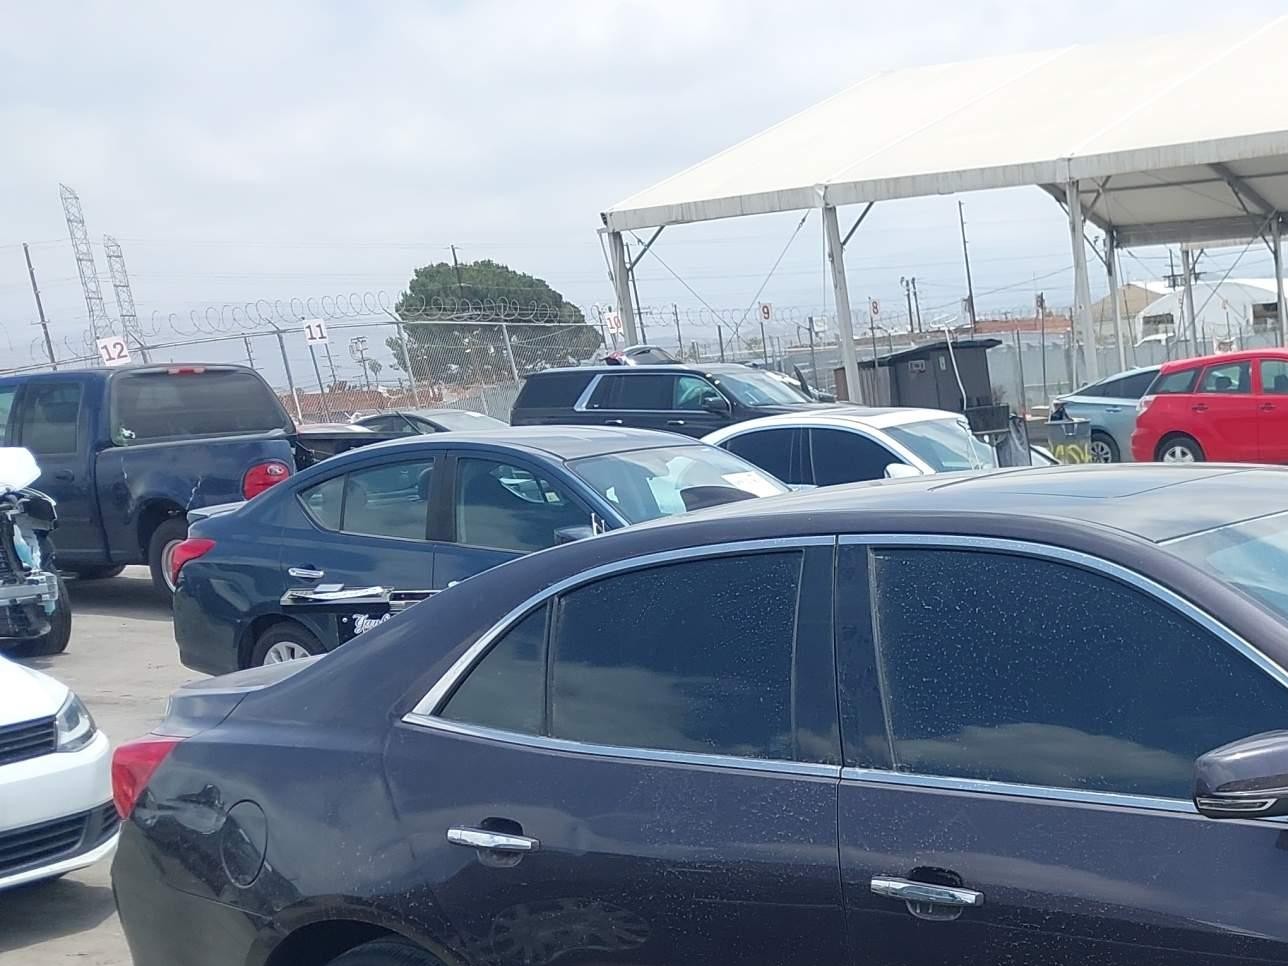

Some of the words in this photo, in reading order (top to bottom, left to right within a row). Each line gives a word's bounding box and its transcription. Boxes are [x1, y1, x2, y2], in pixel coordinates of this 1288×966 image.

[762, 306, 769, 320] 9
[872, 301, 879, 314] 8
[607, 316, 621, 329] 10
[305, 324, 327, 340] 11
[101, 342, 128, 361] 12
